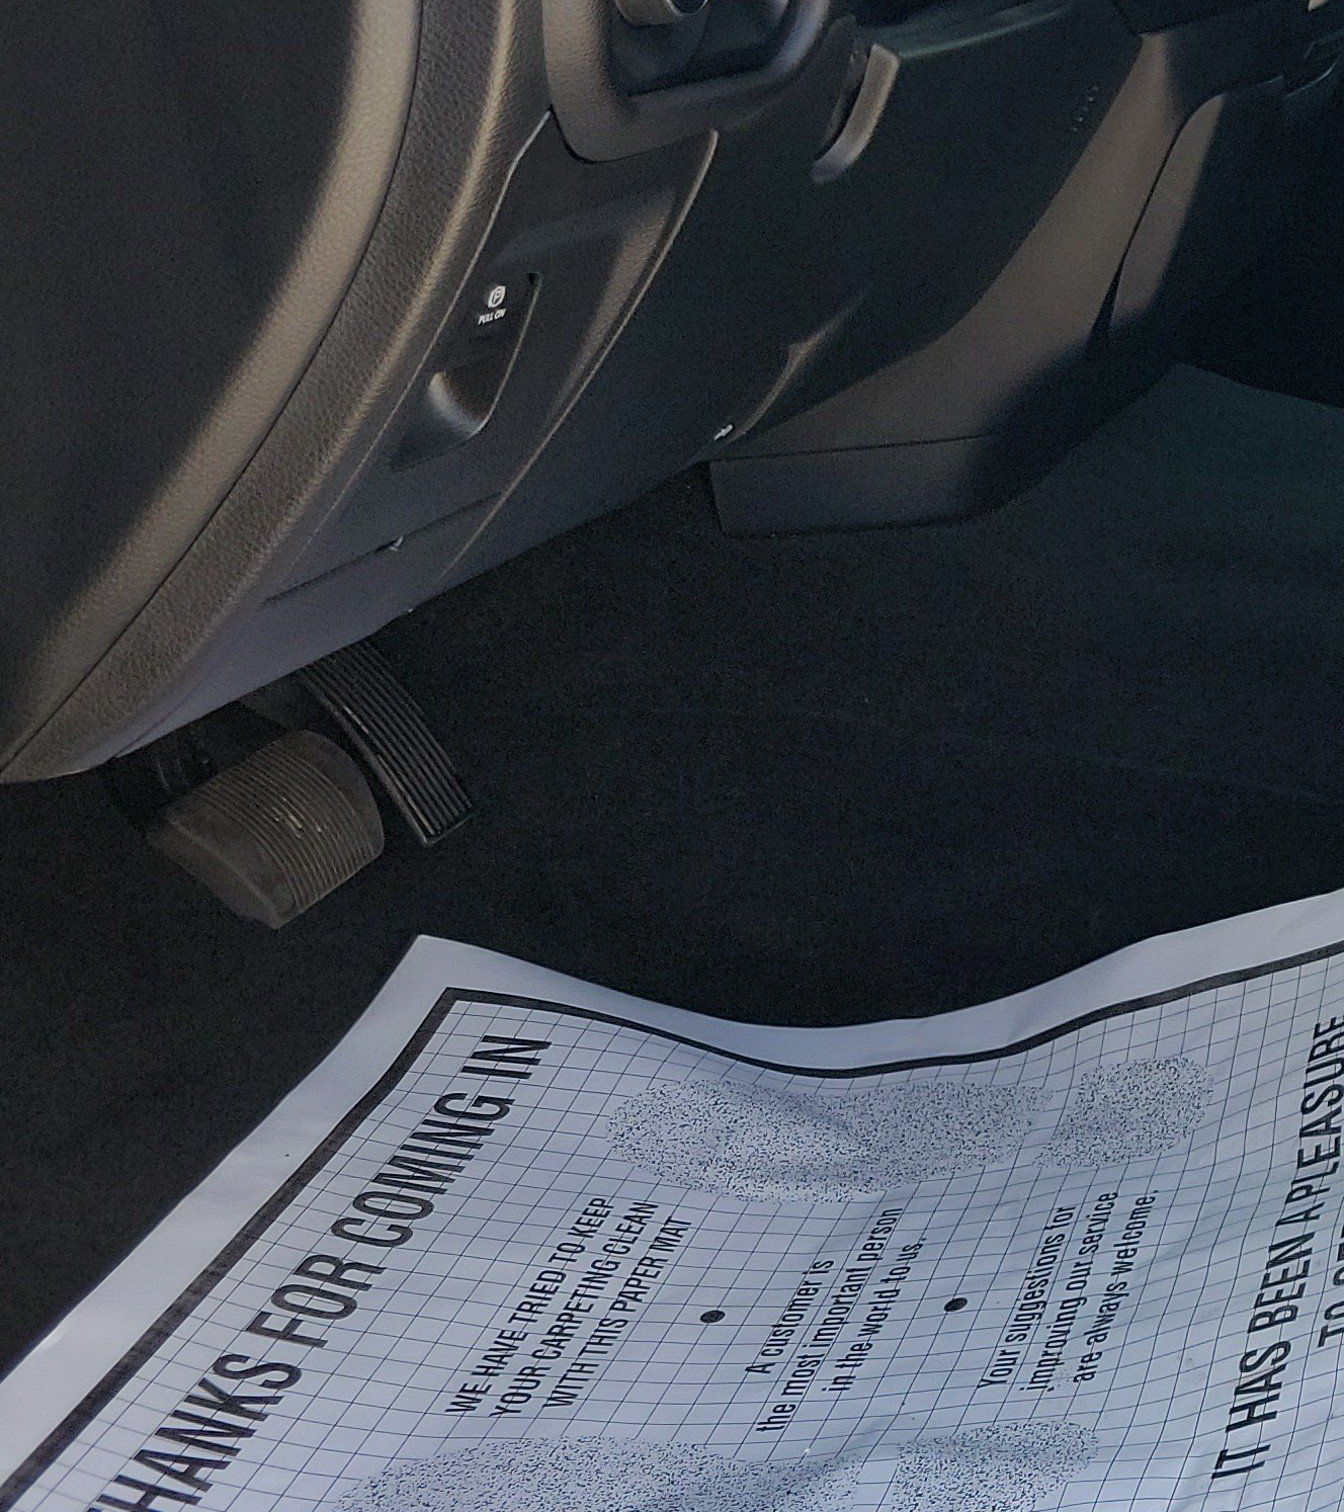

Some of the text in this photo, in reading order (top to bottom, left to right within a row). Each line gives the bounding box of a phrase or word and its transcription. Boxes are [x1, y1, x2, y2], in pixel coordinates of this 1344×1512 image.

[88, 1034, 552, 1512] HANKS FOR COMING IN
[977, 1206, 1076, 1388] Your suggestions for
[1019, 1192, 1118, 1392] improving our service
[1073, 1189, 1158, 1382] are always welcome.
[1247, 1225, 1316, 1334] BEEN
[1275, 1187, 1324, 1229] A
[445, 1198, 614, 1412] WE HAVE TRIED TO KEEP
[490, 1201, 659, 1417] YOUR CARPETING CLEAN
[543, 1216, 692, 1408] WITH THIS PAPER MAT
[745, 1260, 834, 1374] A customer is
[756, 1208, 902, 1432] the most important person
[822, 1238, 927, 1392] in the world to us.
[1226, 1339, 1292, 1433] HAS
[1211, 1443, 1271, 1480] IT
